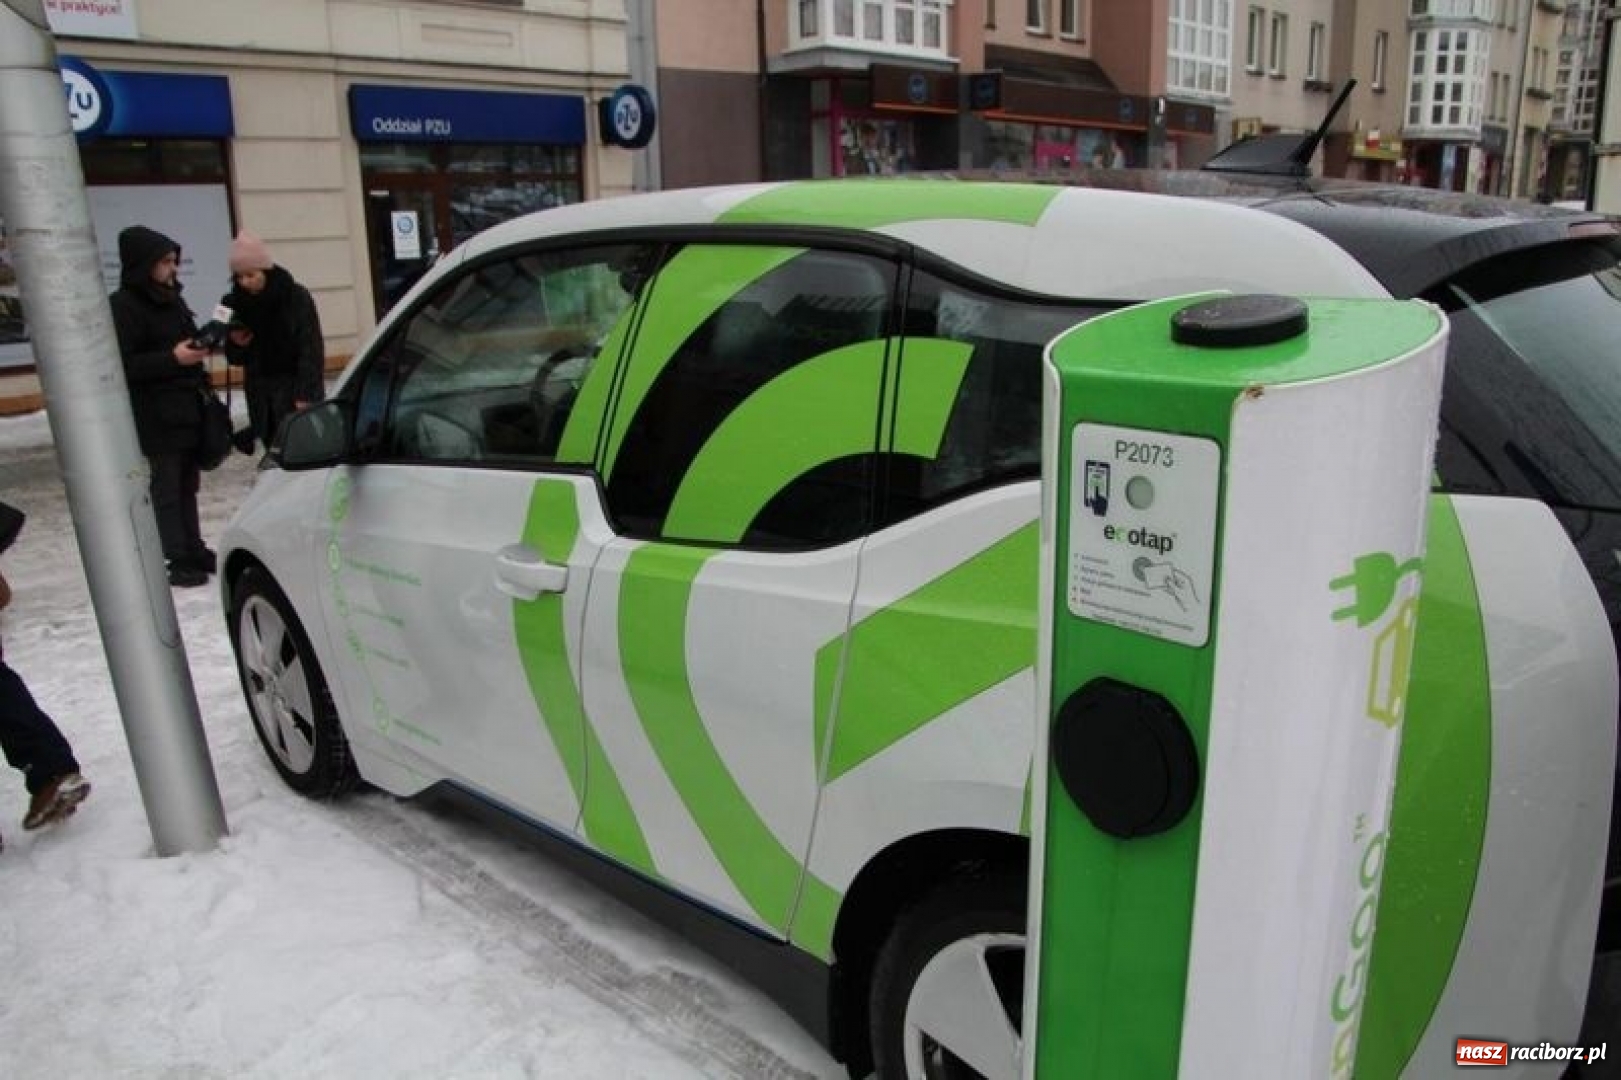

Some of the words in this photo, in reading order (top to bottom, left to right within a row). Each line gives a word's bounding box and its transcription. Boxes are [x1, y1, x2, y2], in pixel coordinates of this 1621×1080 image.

[372, 117, 422, 134] Oddział
[425, 118, 451, 136] PZU
[1115, 440, 1174, 468] P2073
